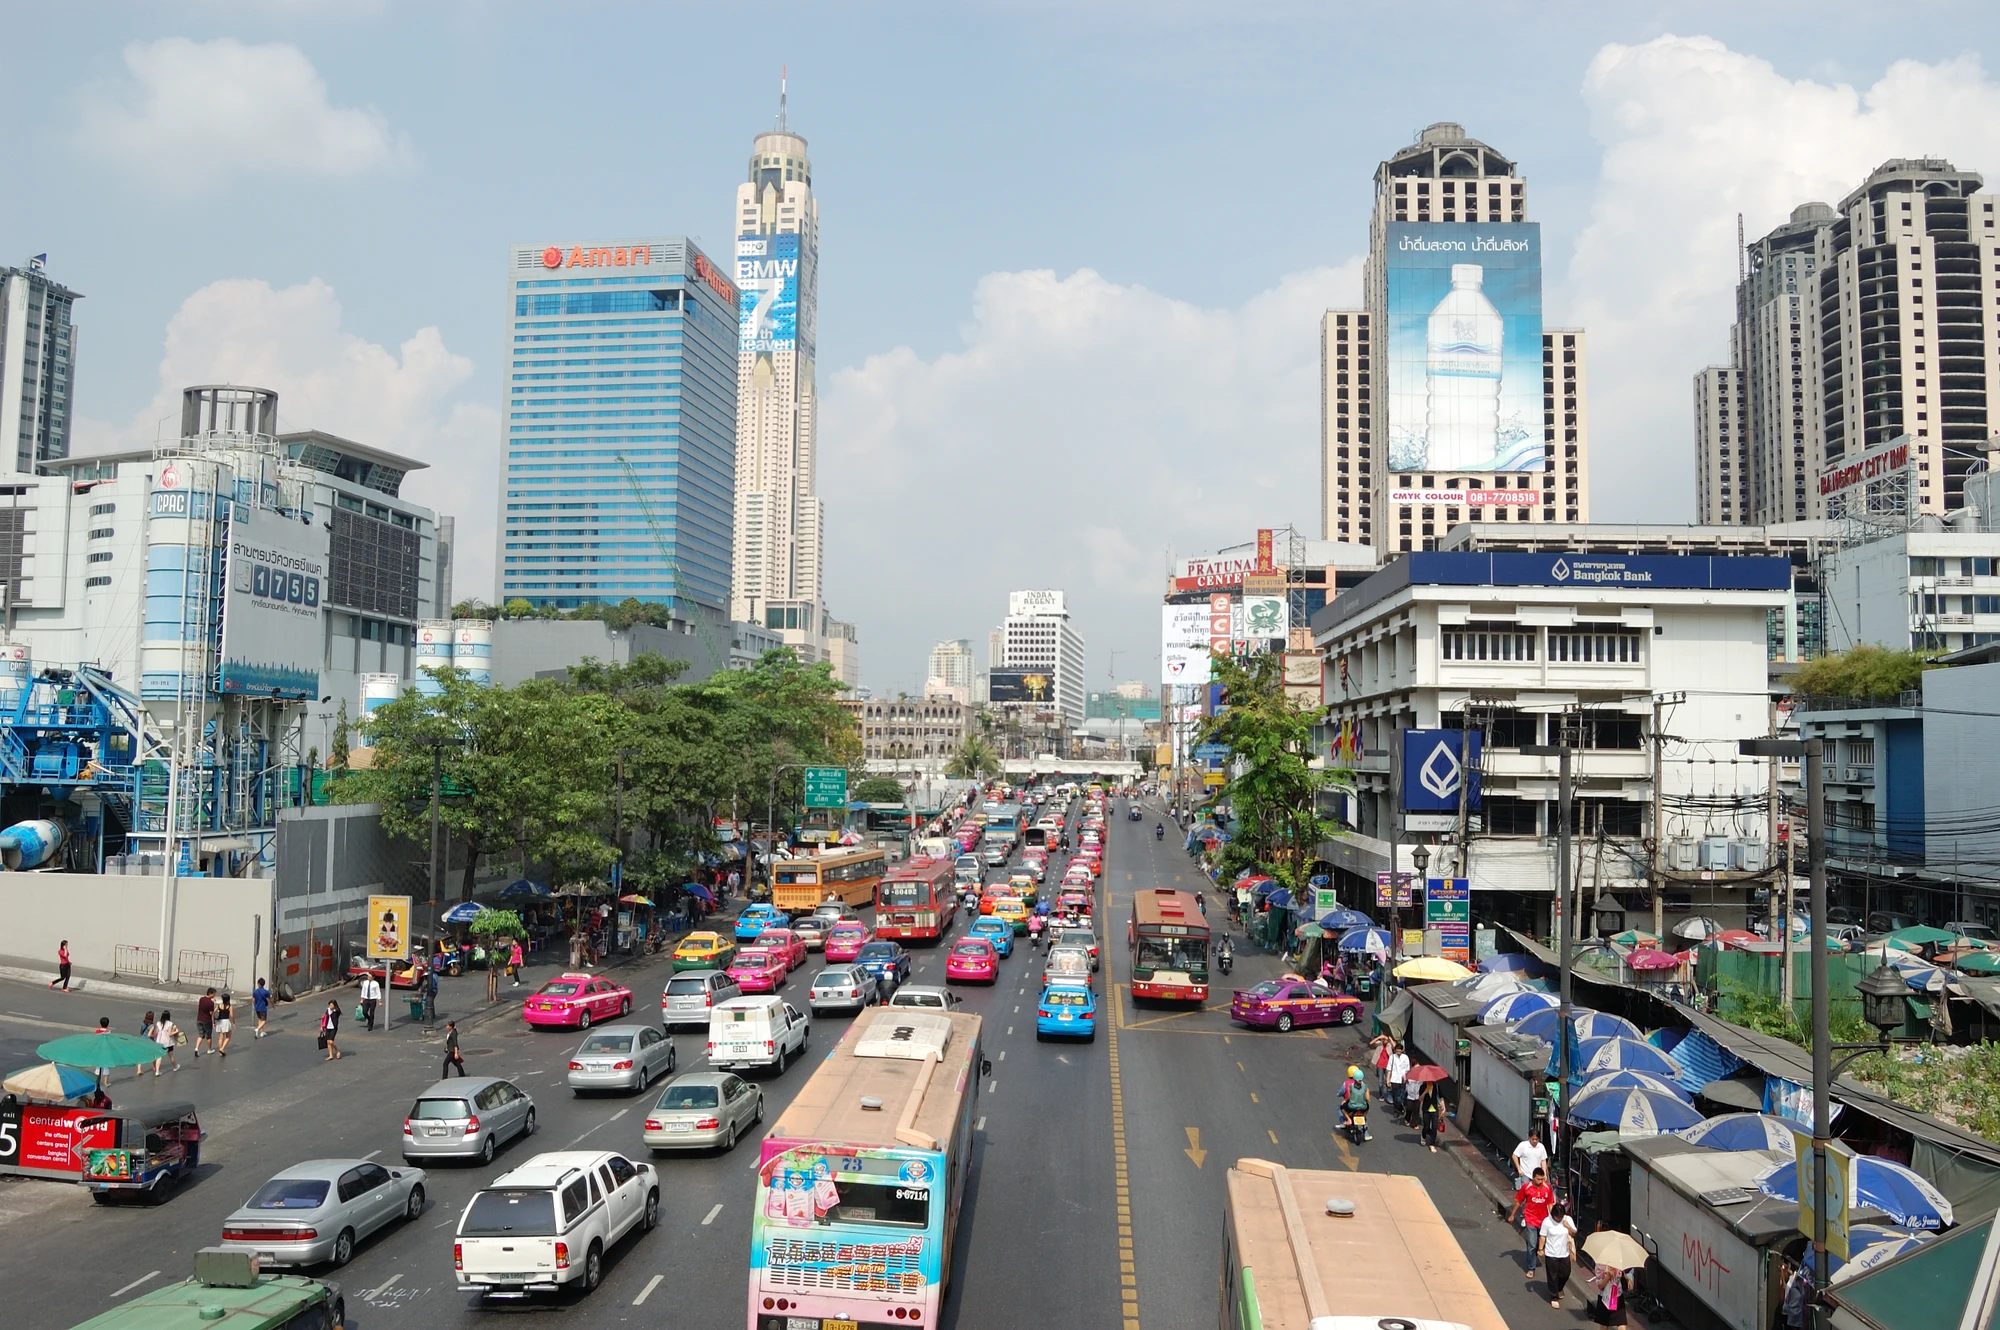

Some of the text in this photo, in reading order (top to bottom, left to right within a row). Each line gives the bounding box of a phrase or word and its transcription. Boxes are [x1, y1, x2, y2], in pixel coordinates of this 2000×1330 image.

[1399, 235, 1529, 252] น้ำดื่มสะอาด น้ำดื่มสิงห์
[566, 245, 650, 268] Amari
[737, 259, 798, 279] BMW
[705, 264, 733, 304] Amari
[736, 278, 784, 340] 7
[760, 328, 773, 339] th
[1820, 461, 1864, 496] BANGKOK
[1865, 452, 1888, 479] CITY
[156, 494, 185, 512] CPAC
[1470, 493, 1535, 502] 081-7708518
[1573, 570, 1652, 582] Bangkok Bank
[257, 569, 316, 601] 1755
[420, 644, 435, 655] CPAC
[459, 644, 474, 655] CPAC
[0, 1122, 18, 1156] 5
[842, 1158, 863, 1171] 73
[895, 1189, 929, 1201] 8-67114
[1906, 1215, 1940, 1228] Mc Jeans
[1860, 1248, 1889, 1269] Jeans
[787, 1318, 820, 1330] Plan+B
